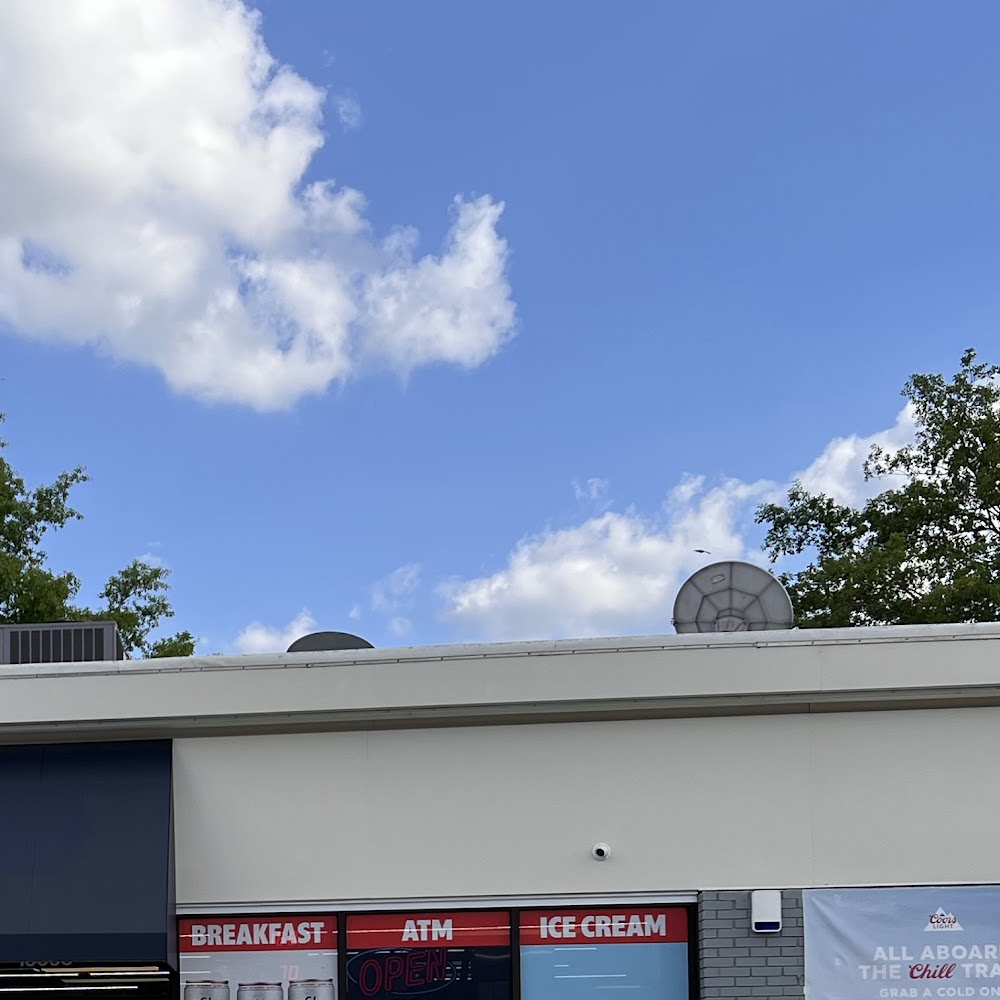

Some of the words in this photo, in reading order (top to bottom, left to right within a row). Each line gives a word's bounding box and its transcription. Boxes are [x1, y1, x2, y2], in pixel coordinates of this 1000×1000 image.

[540, 916, 577, 939] ICE
[580, 914, 667, 938] CREAM
[929, 913, 957, 924] Coors
[191, 922, 325, 947] BREAKFAST
[401, 919, 453, 942] ATM
[873, 946, 914, 961] ALL
[920, 945, 1000, 960] ABOAR
[358, 949, 448, 996] OPEN
[859, 964, 901, 979] THE
[908, 963, 957, 980] Chill
[879, 988, 918, 998] GRAB
[922, 988, 933, 998] A
[937, 987, 975, 997] COLD
